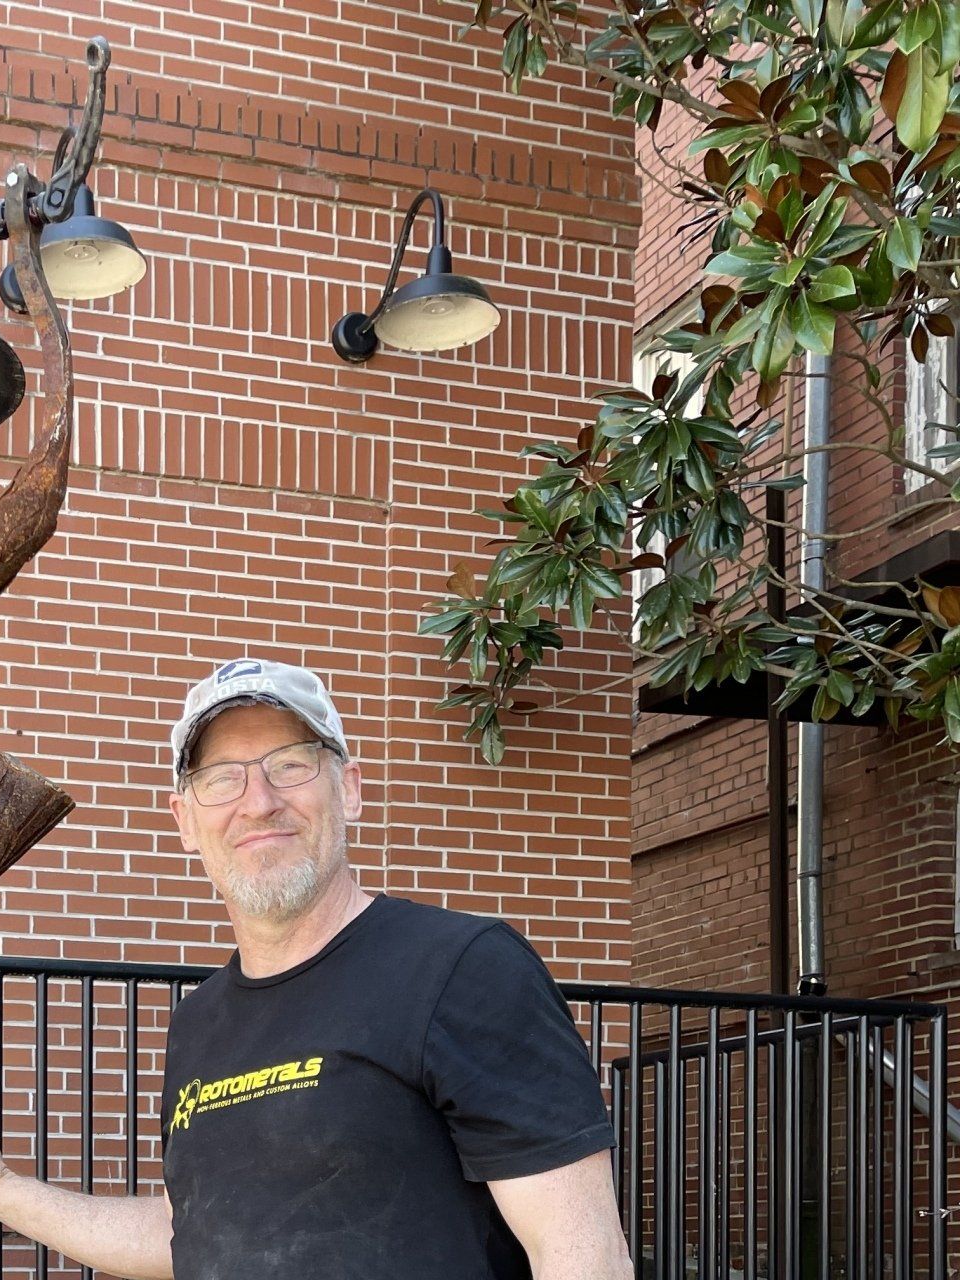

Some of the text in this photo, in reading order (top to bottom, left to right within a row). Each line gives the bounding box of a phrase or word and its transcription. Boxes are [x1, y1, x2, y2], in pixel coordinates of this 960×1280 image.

[232, 1094, 252, 1105] METALS
[253, 1090, 265, 1099] AND
[266, 1084, 290, 1095] CUSTOM
[292, 1079, 319, 1090] ALLOYS
